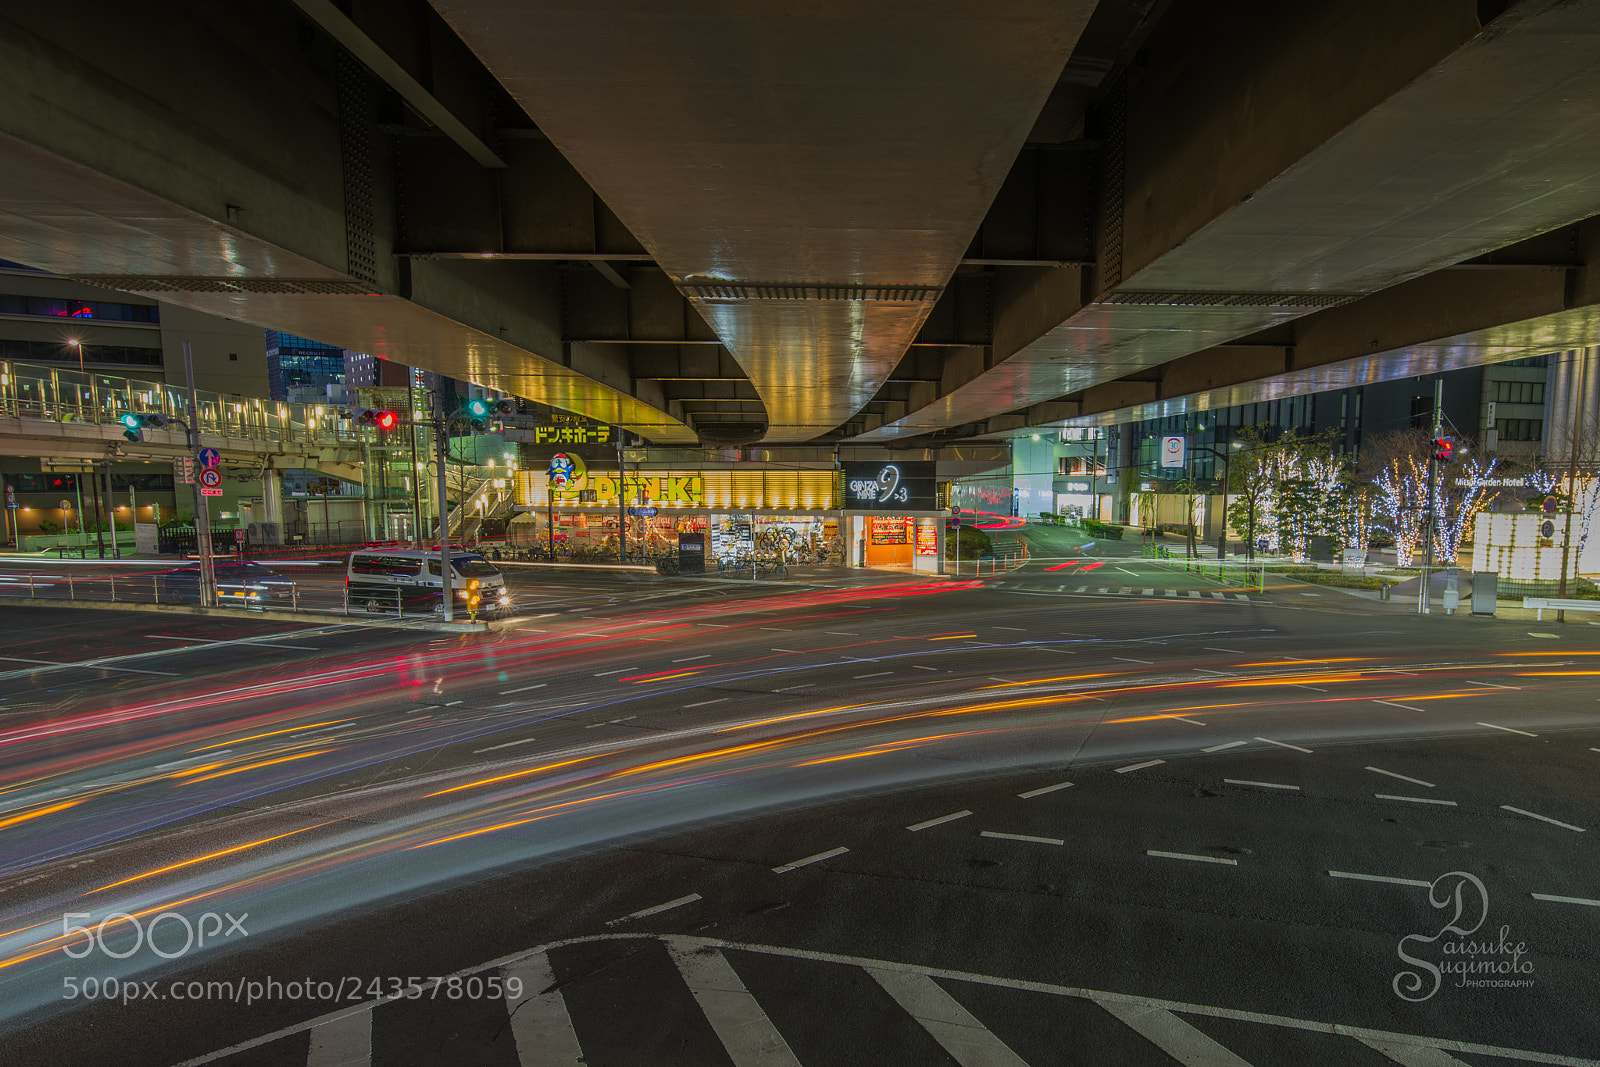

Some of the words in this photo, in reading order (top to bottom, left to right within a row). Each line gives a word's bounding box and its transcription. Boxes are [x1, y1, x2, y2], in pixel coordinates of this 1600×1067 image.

[1170, 441, 1179, 450] 30
[850, 480, 879, 492] GINZA
[1477, 477, 1501, 487] Garden
[1502, 477, 1524, 487] Hotel
[857, 490, 876, 500] NINE
